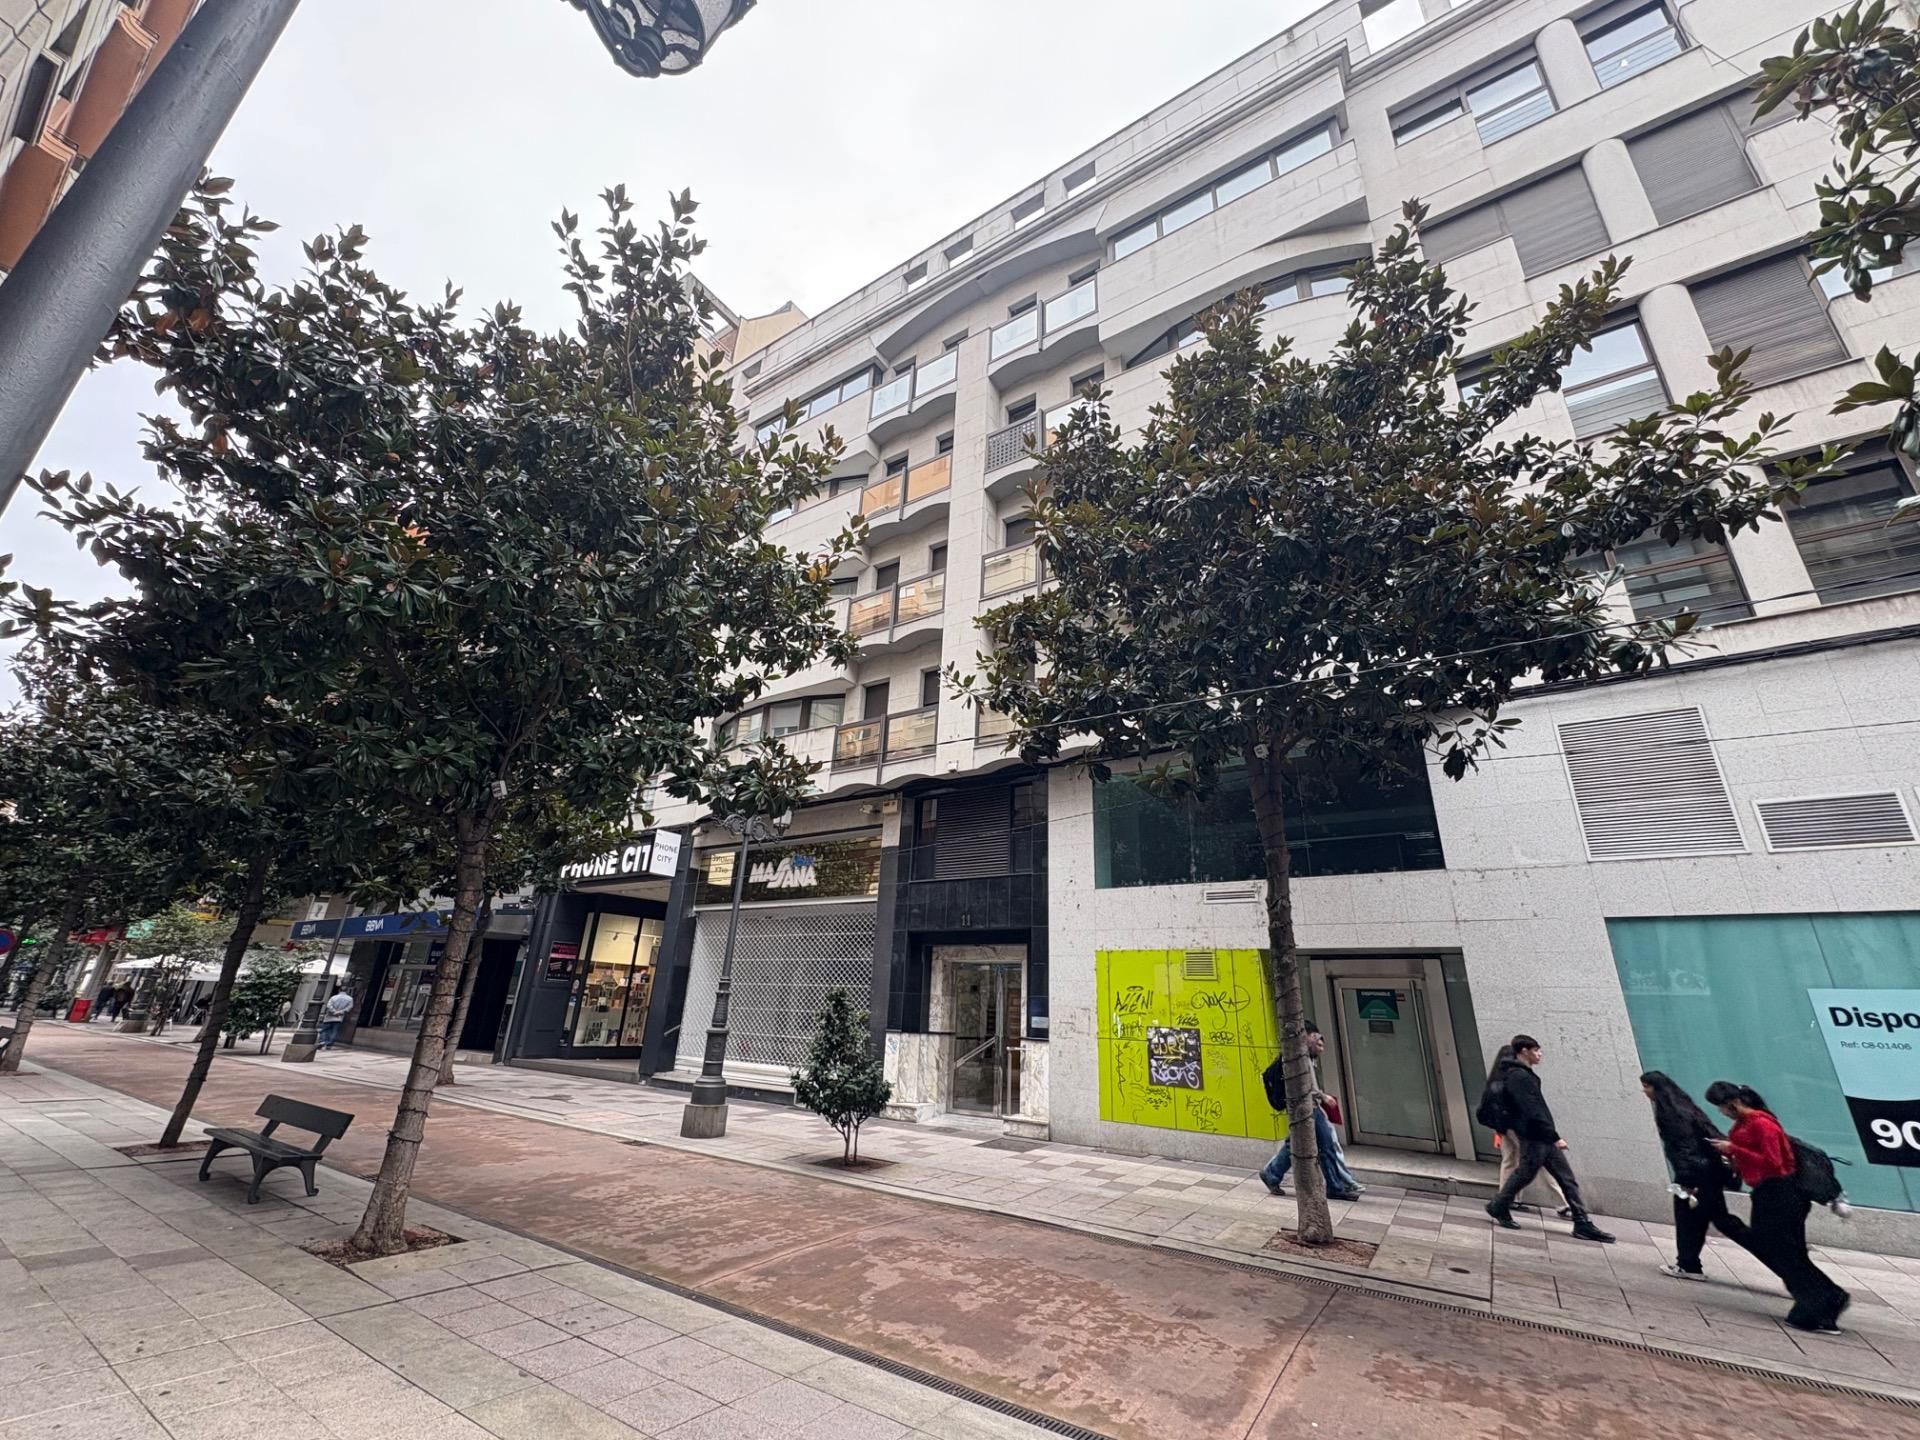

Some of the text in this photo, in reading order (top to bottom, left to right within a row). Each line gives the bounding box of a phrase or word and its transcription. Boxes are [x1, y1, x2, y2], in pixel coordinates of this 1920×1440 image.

[654, 841, 678, 853] PHONE
[656, 854, 673, 864] CITY
[748, 857, 818, 889] MASSANA
[365, 919, 384, 932] BBVA
[961, 914, 971, 926] 11
[301, 924, 316, 935] BBVA
[1840, 1040, 1860, 1049] Ref:
